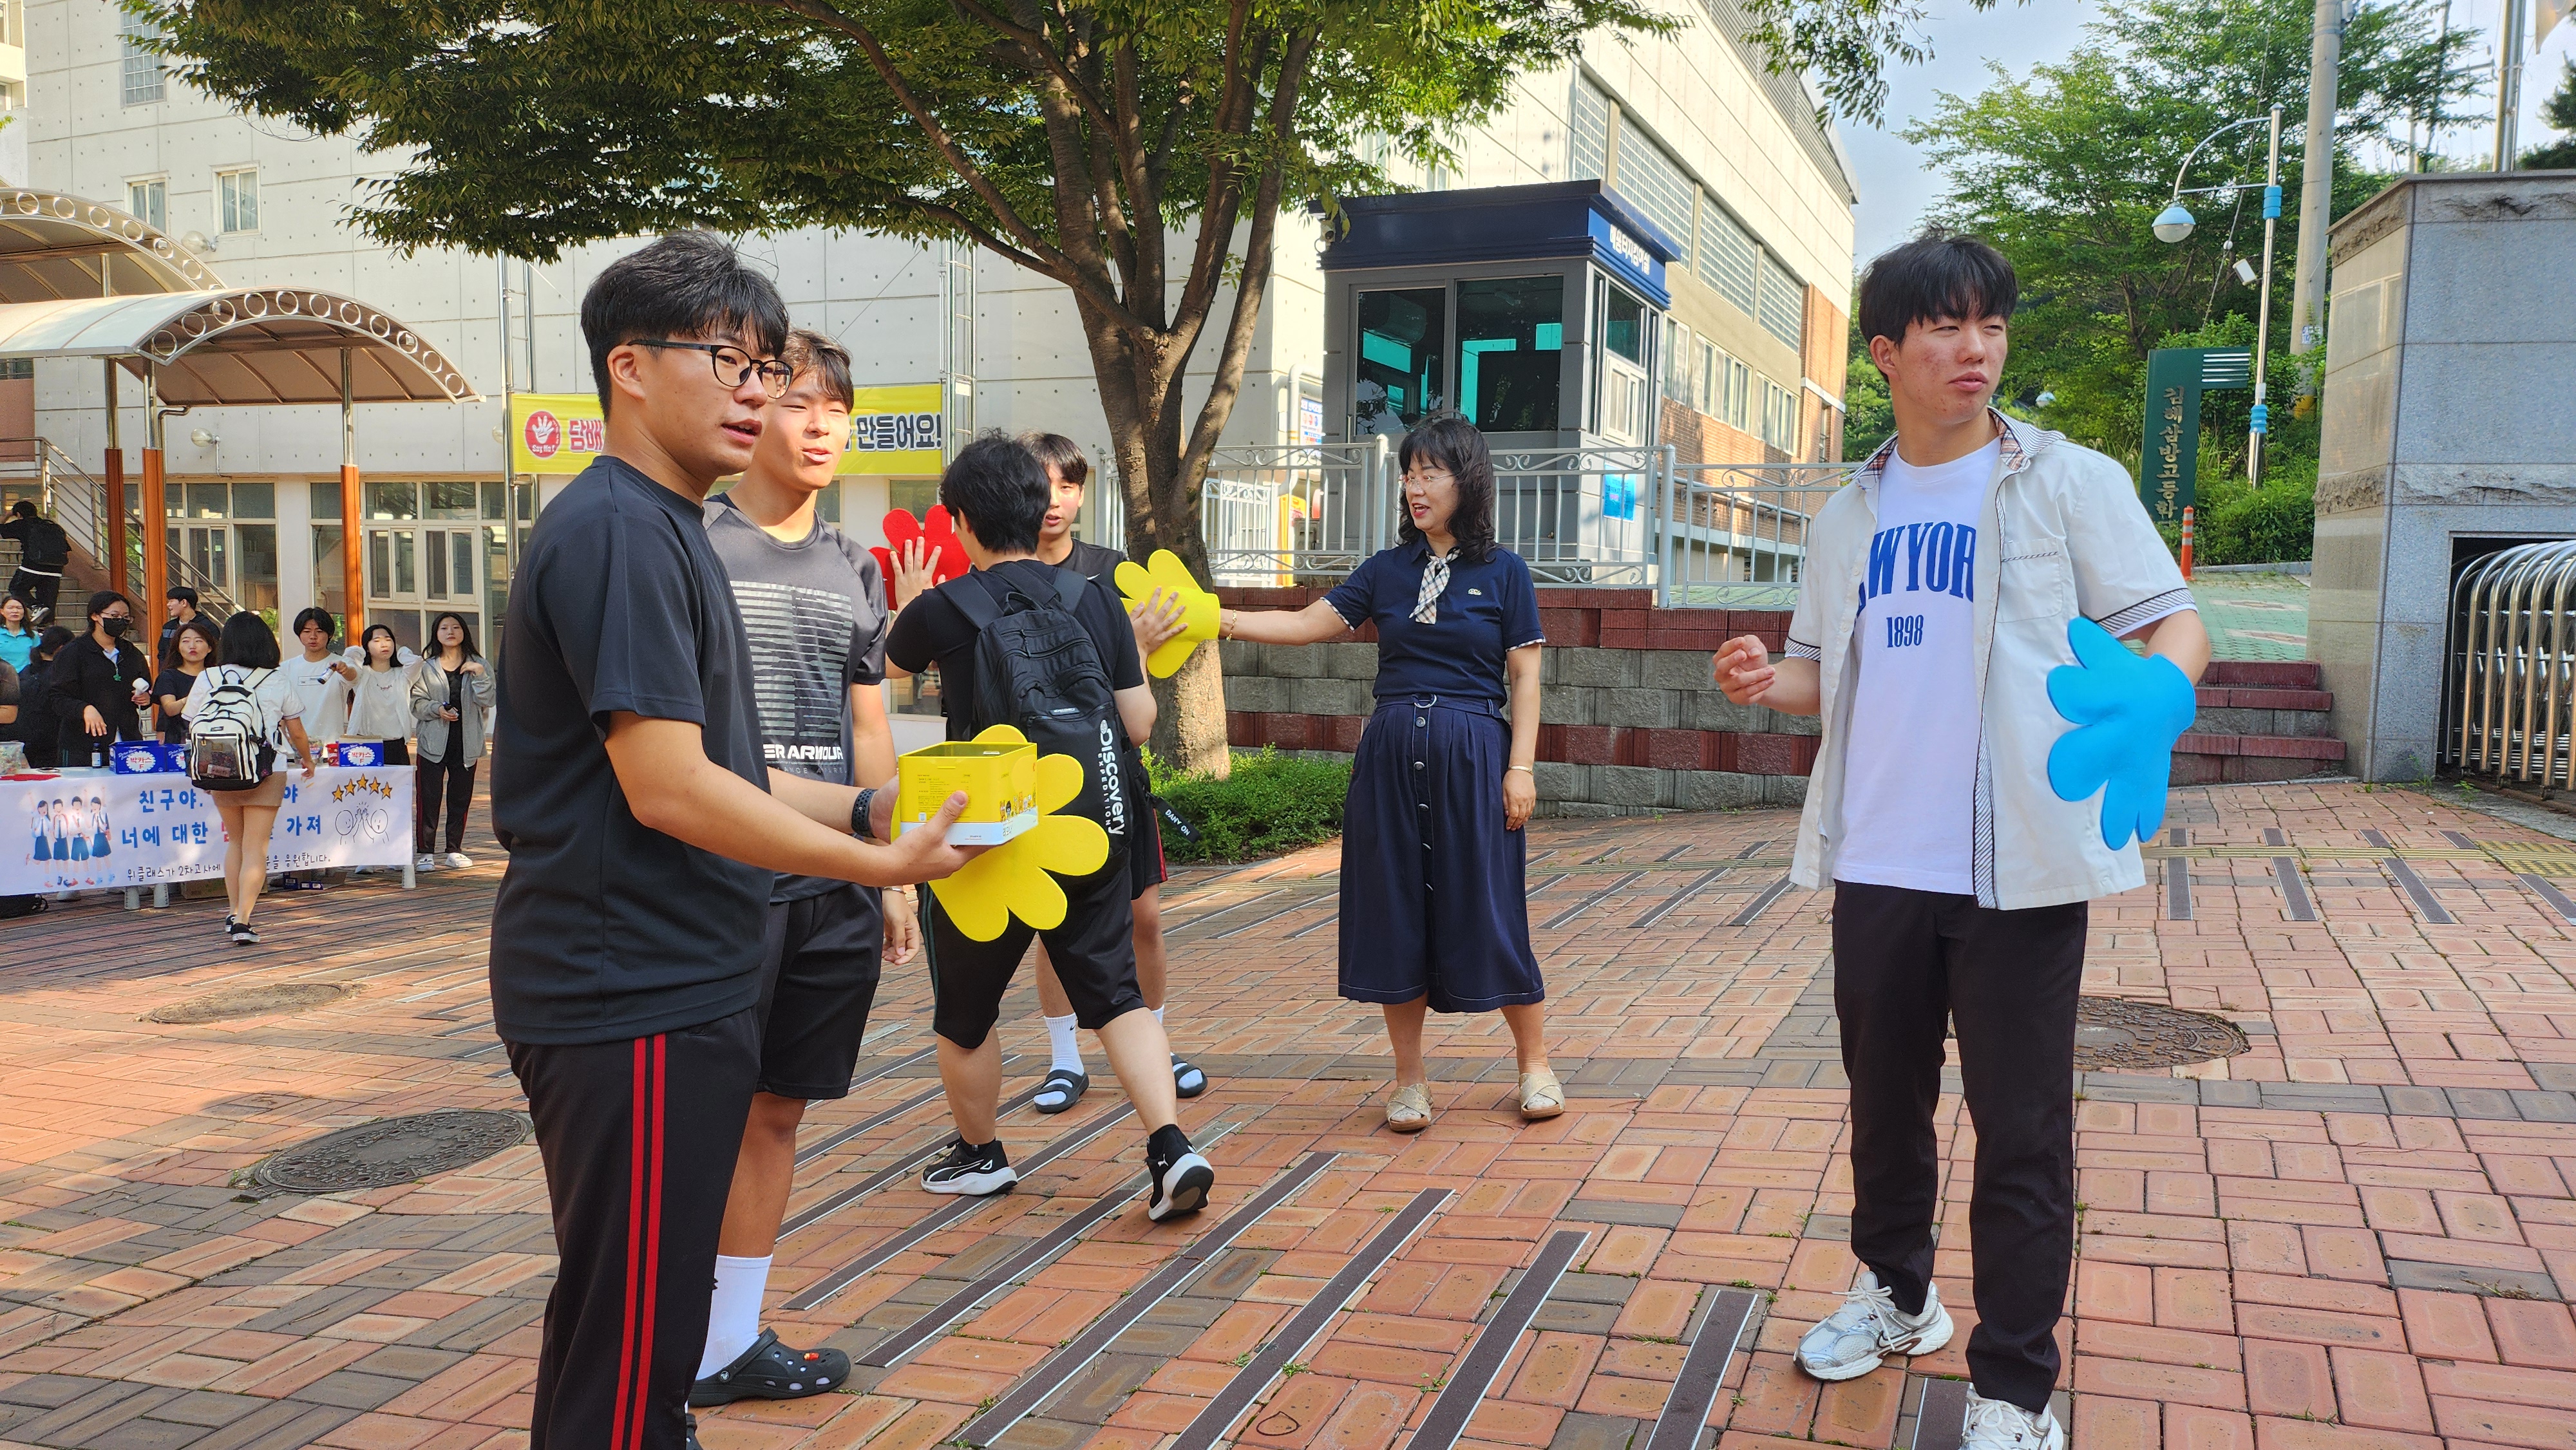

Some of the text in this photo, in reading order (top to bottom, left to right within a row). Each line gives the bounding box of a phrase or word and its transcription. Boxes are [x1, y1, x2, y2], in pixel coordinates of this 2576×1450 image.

[857, 414, 942, 449] 만들어요!
[1886, 614, 1924, 648] 1898
[787, 745, 844, 760] ARMOUR
[139, 788, 203, 813] 친구야.
[1098, 753, 1112, 826] EXPEDITION
[122, 825, 160, 848] 너에
[172, 822, 209, 844] 대한
[287, 814, 321, 836] 가져
[1165, 809, 1191, 836] DANY ON
[128, 866, 175, 881] 위클래스가
[285, 852, 331, 867] 응원합니다.
